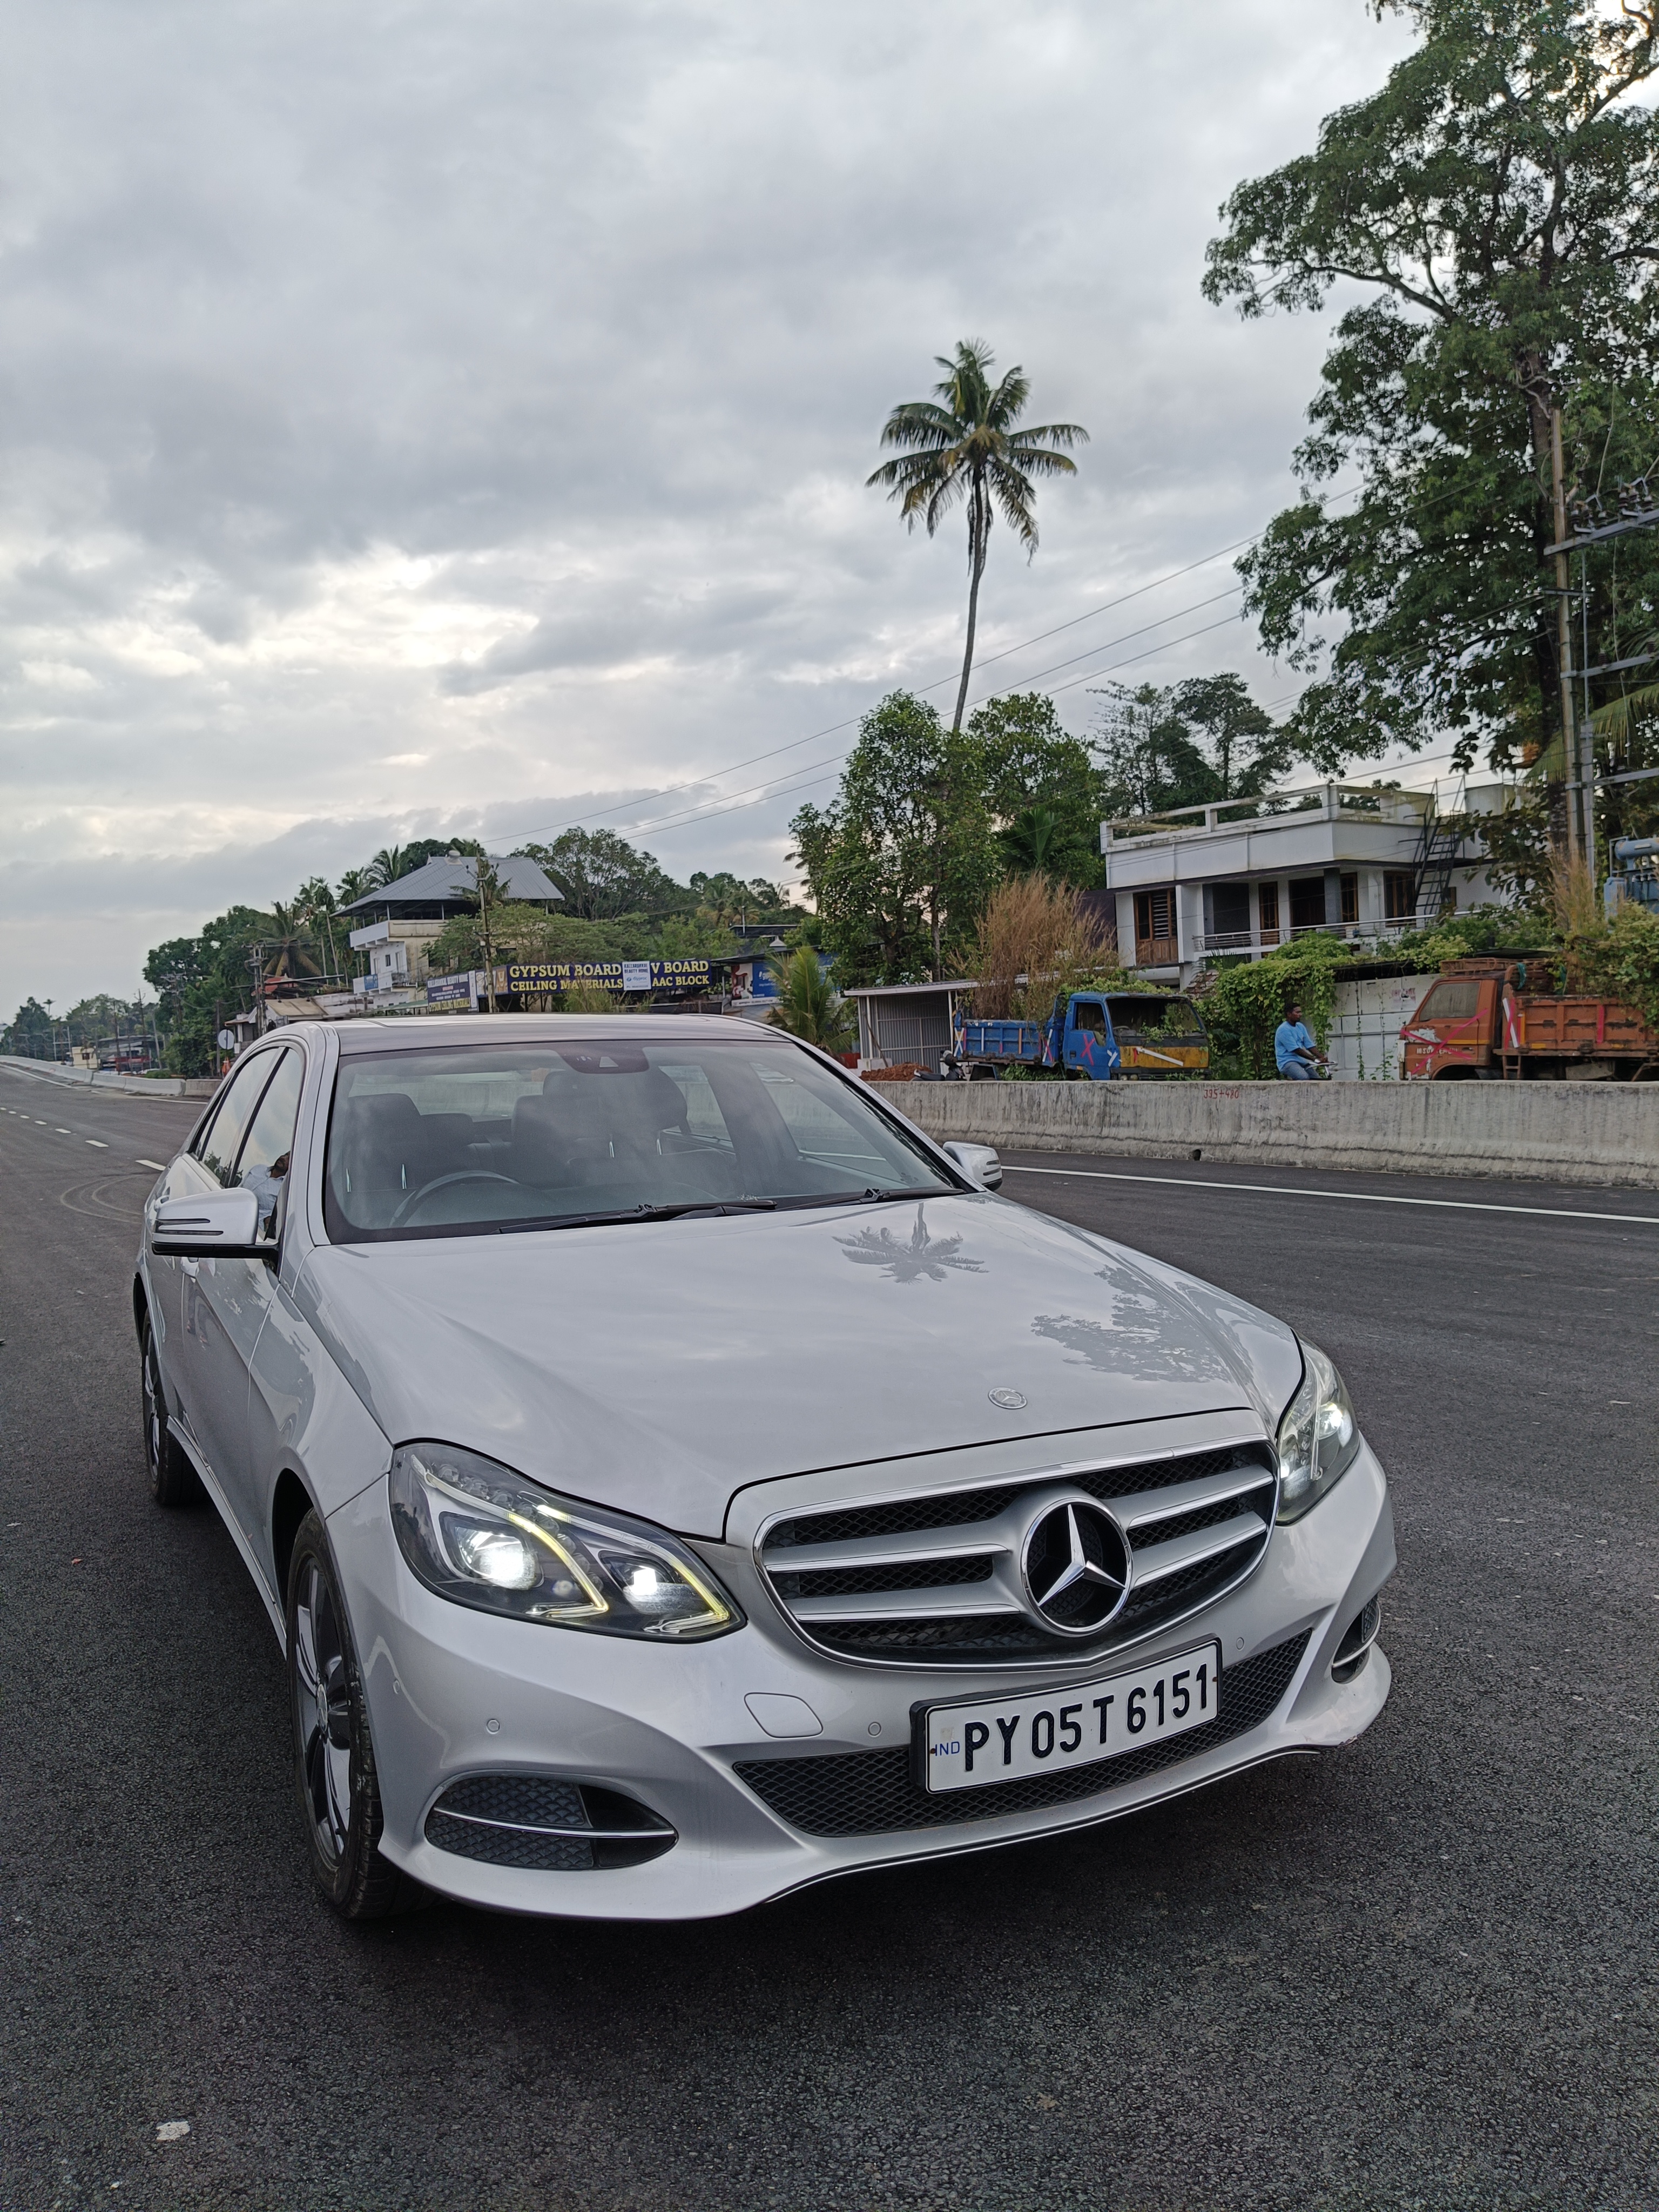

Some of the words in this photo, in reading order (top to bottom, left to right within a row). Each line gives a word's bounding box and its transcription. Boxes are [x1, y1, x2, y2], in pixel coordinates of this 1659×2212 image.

[509, 965, 570, 977] GYPSUM
[574, 964, 622, 976] BOARD
[651, 962, 660, 974] V
[664, 961, 709, 973] BOARD
[510, 980, 557, 991] CEILING
[652, 977, 673, 987] AAC
[676, 975, 710, 986] BLOCK
[965, 1715, 1021, 1771] PY
[1031, 1703, 1083, 1759] 05
[1093, 1695, 1114, 1744] T
[1127, 1663, 1208, 1734] 6151
[935, 1741, 960, 1757] IND
